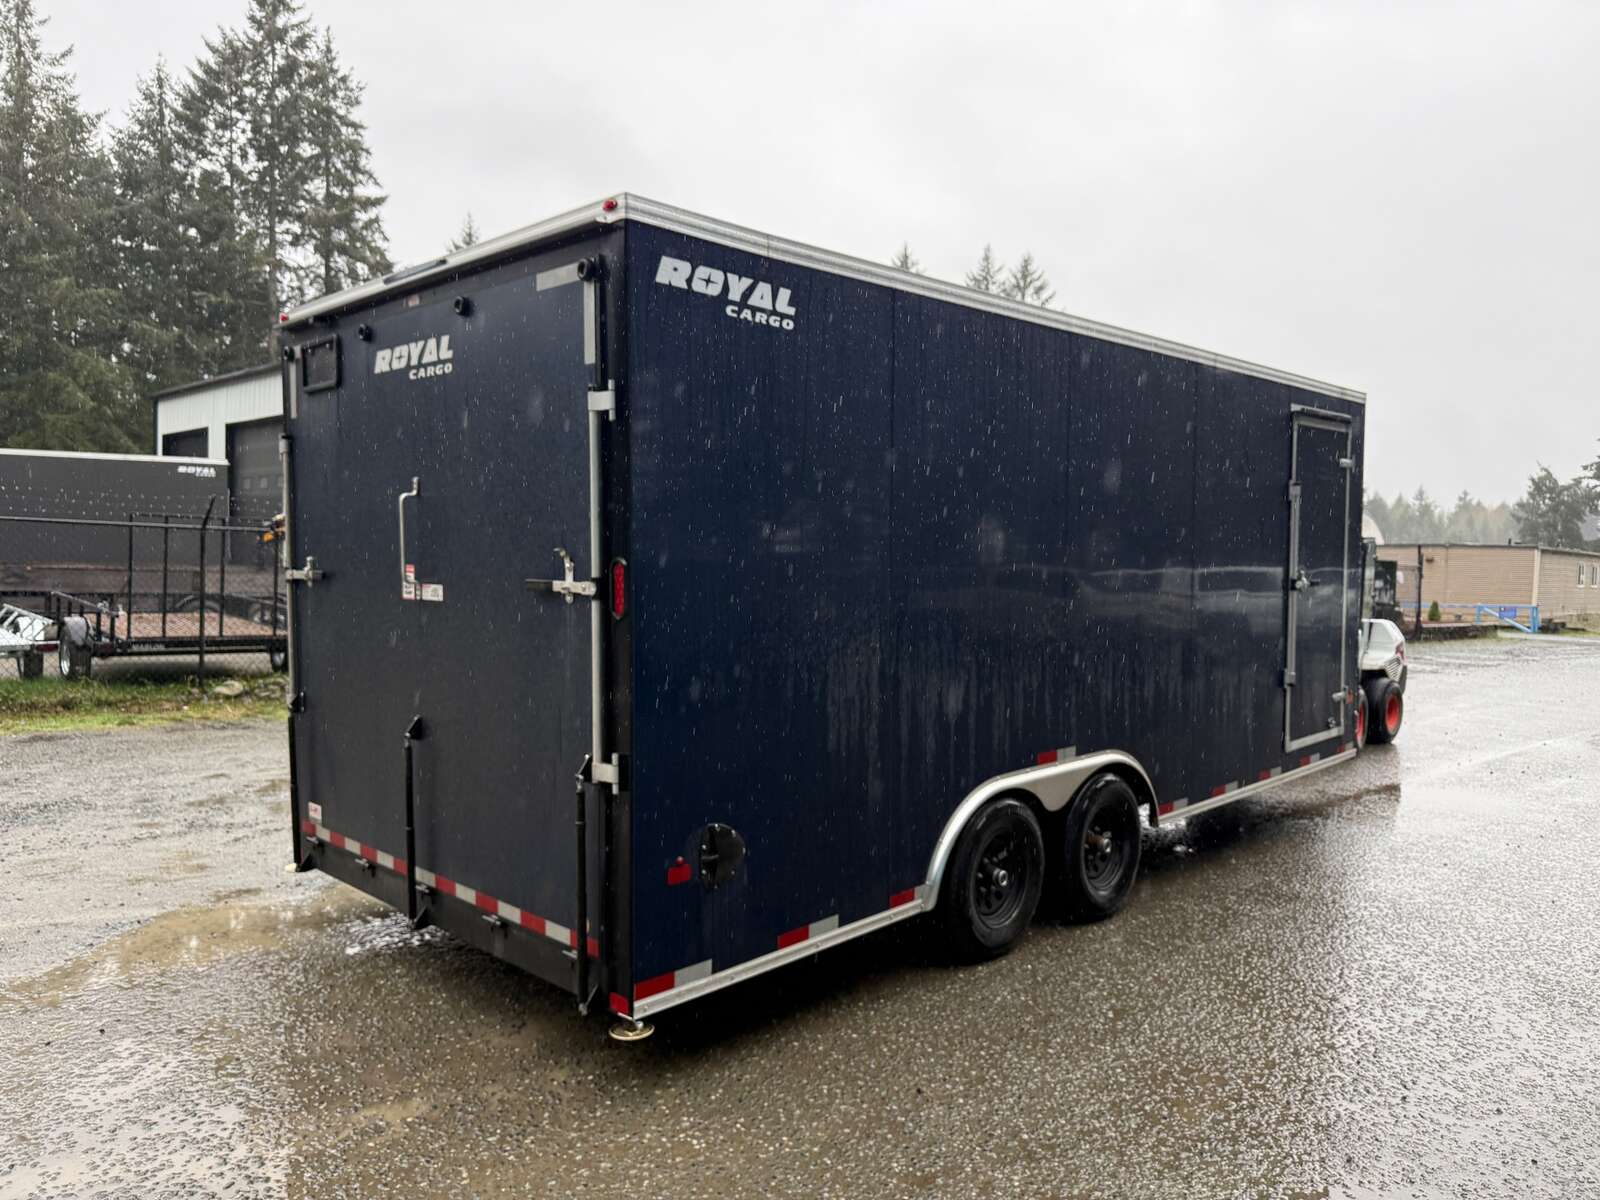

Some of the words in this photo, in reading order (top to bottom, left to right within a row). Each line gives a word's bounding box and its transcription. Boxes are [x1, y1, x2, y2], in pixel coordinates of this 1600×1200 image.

[655, 255, 796, 316] ROYAL
[725, 305, 795, 331] CARGO
[374, 335, 453, 374] ROYAL
[409, 363, 453, 380] CARGO
